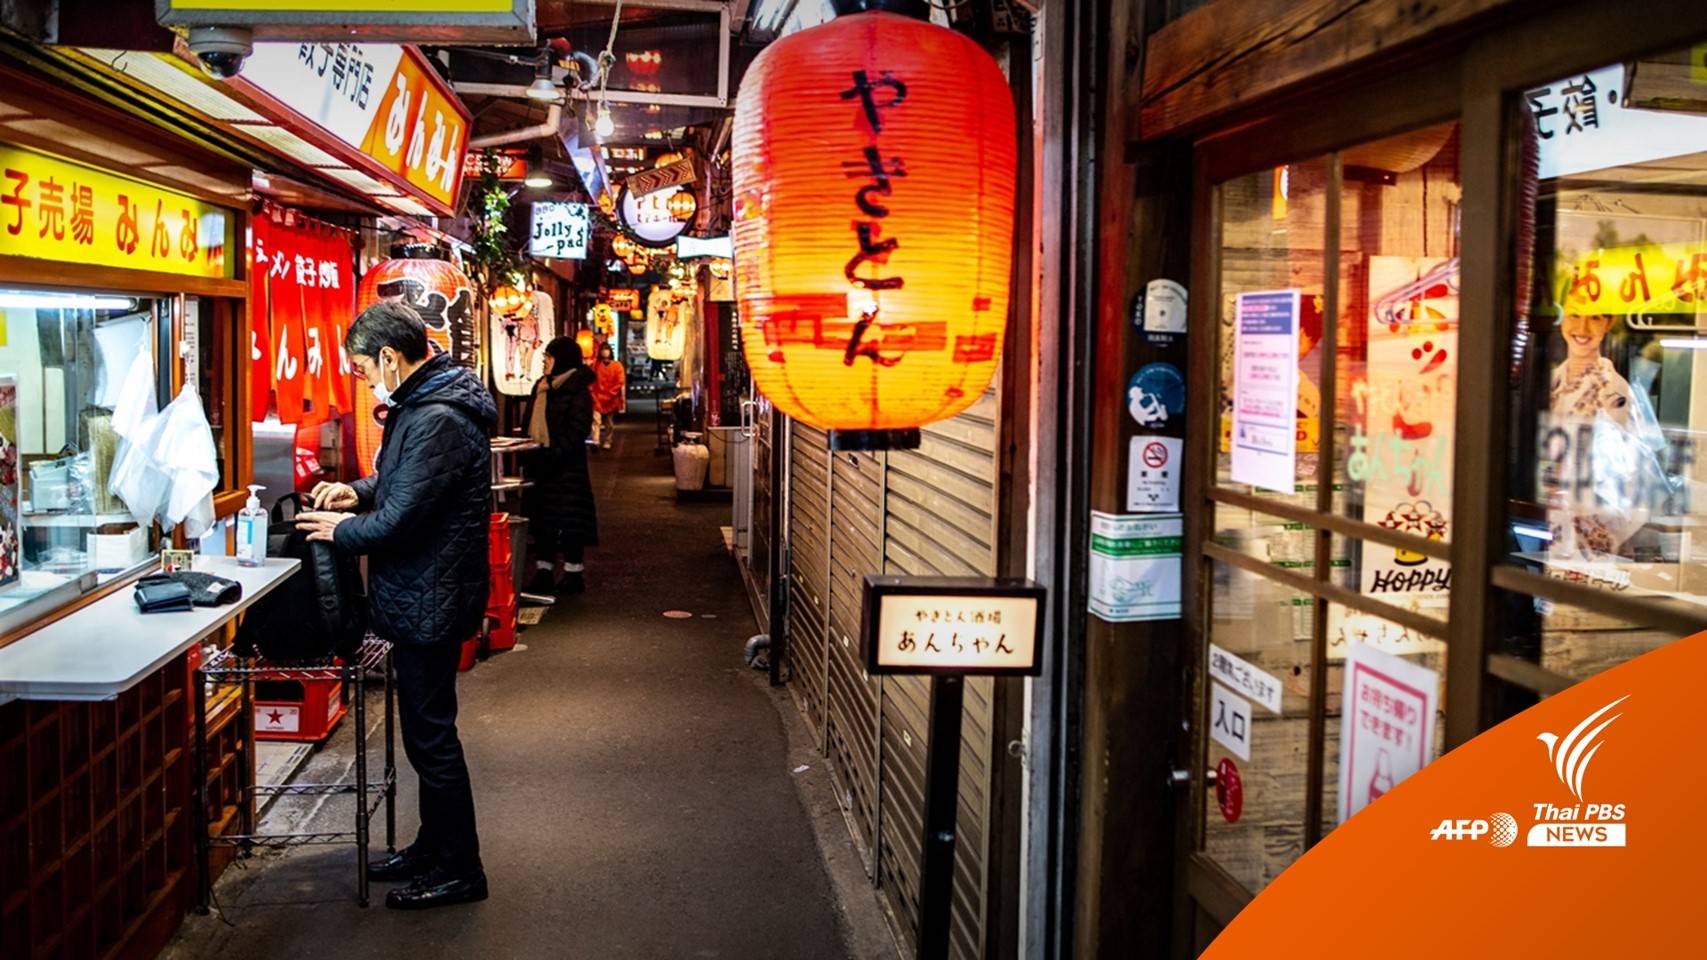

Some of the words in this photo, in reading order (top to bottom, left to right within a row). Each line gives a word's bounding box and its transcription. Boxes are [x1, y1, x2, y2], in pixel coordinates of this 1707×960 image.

[384, 71, 460, 193] みんみん
[1, 168, 94, 245] 子売場
[838, 69, 908, 367] やきとん
[556, 226, 584, 254] pad
[915, 609, 1002, 625] やきとん酒場
[897, 630, 1014, 654] あんちゃん
[1214, 700, 1246, 743] 入口
